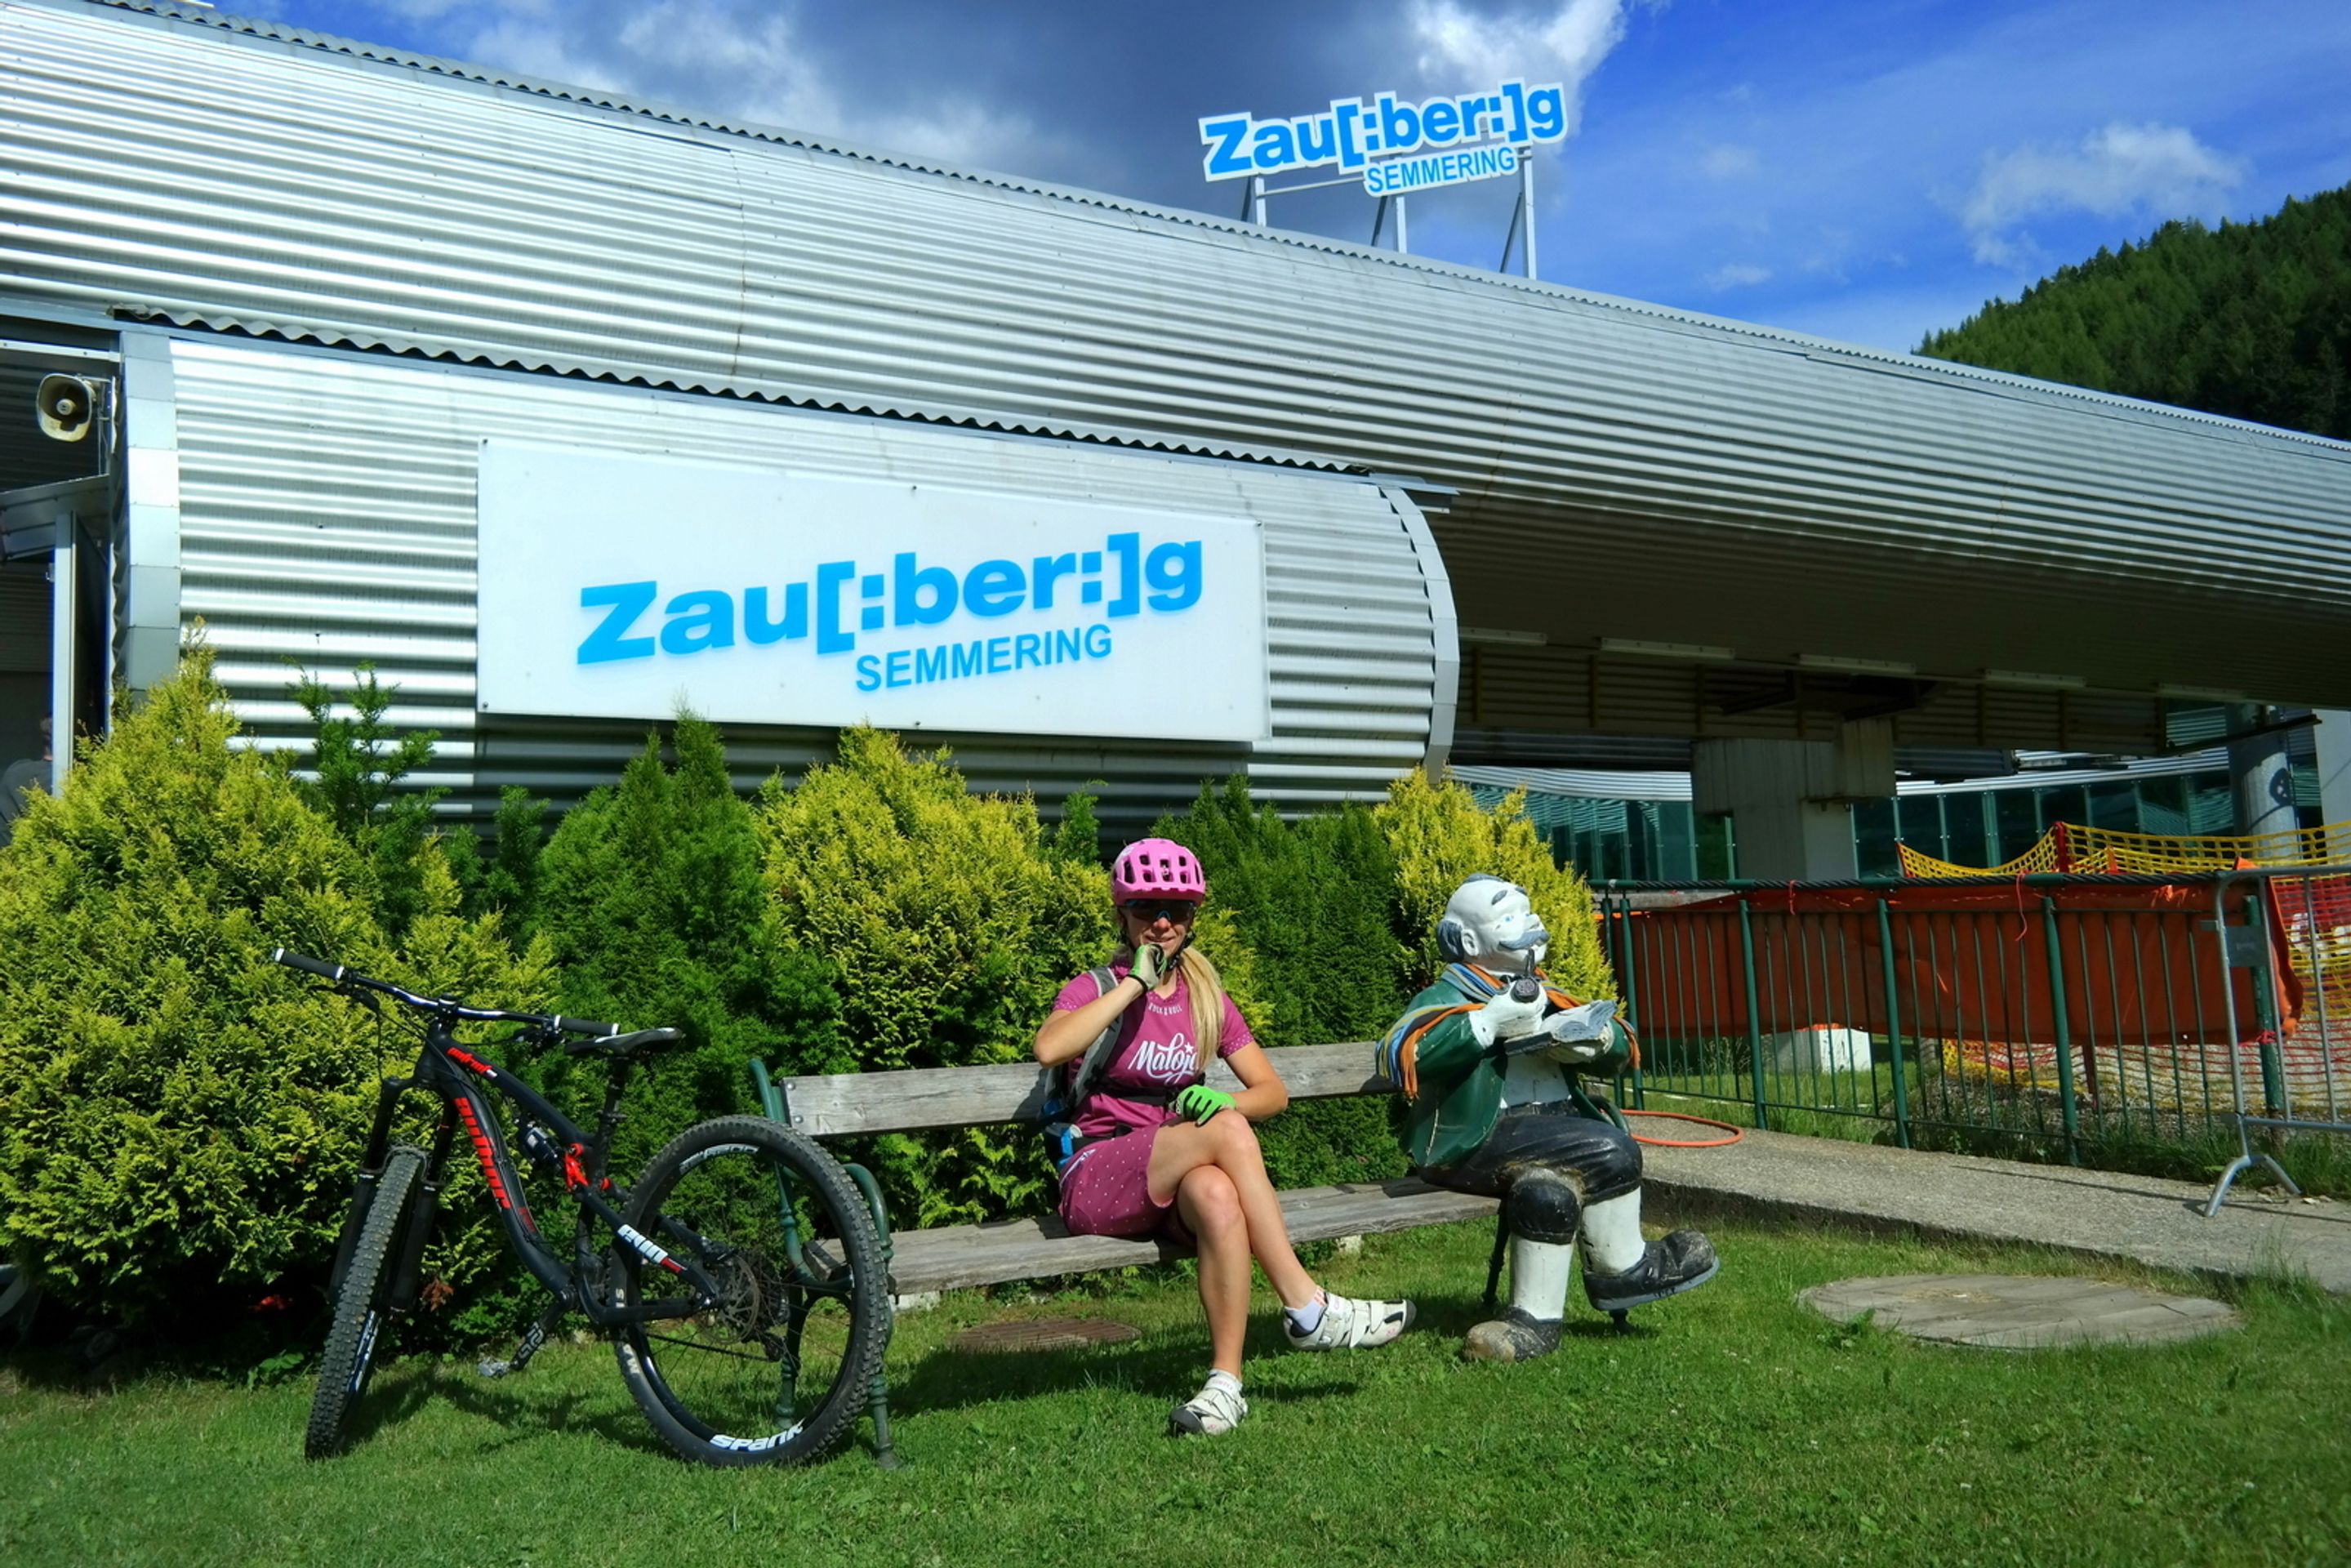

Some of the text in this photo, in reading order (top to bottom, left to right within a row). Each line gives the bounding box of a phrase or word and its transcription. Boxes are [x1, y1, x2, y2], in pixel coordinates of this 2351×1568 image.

[1204, 82, 1565, 175] Zau[:ber:]g
[1368, 146, 1515, 193] SEMMERING
[577, 532, 1202, 665] Zau[:ber:]g
[855, 623, 1112, 692] SEMMERING
